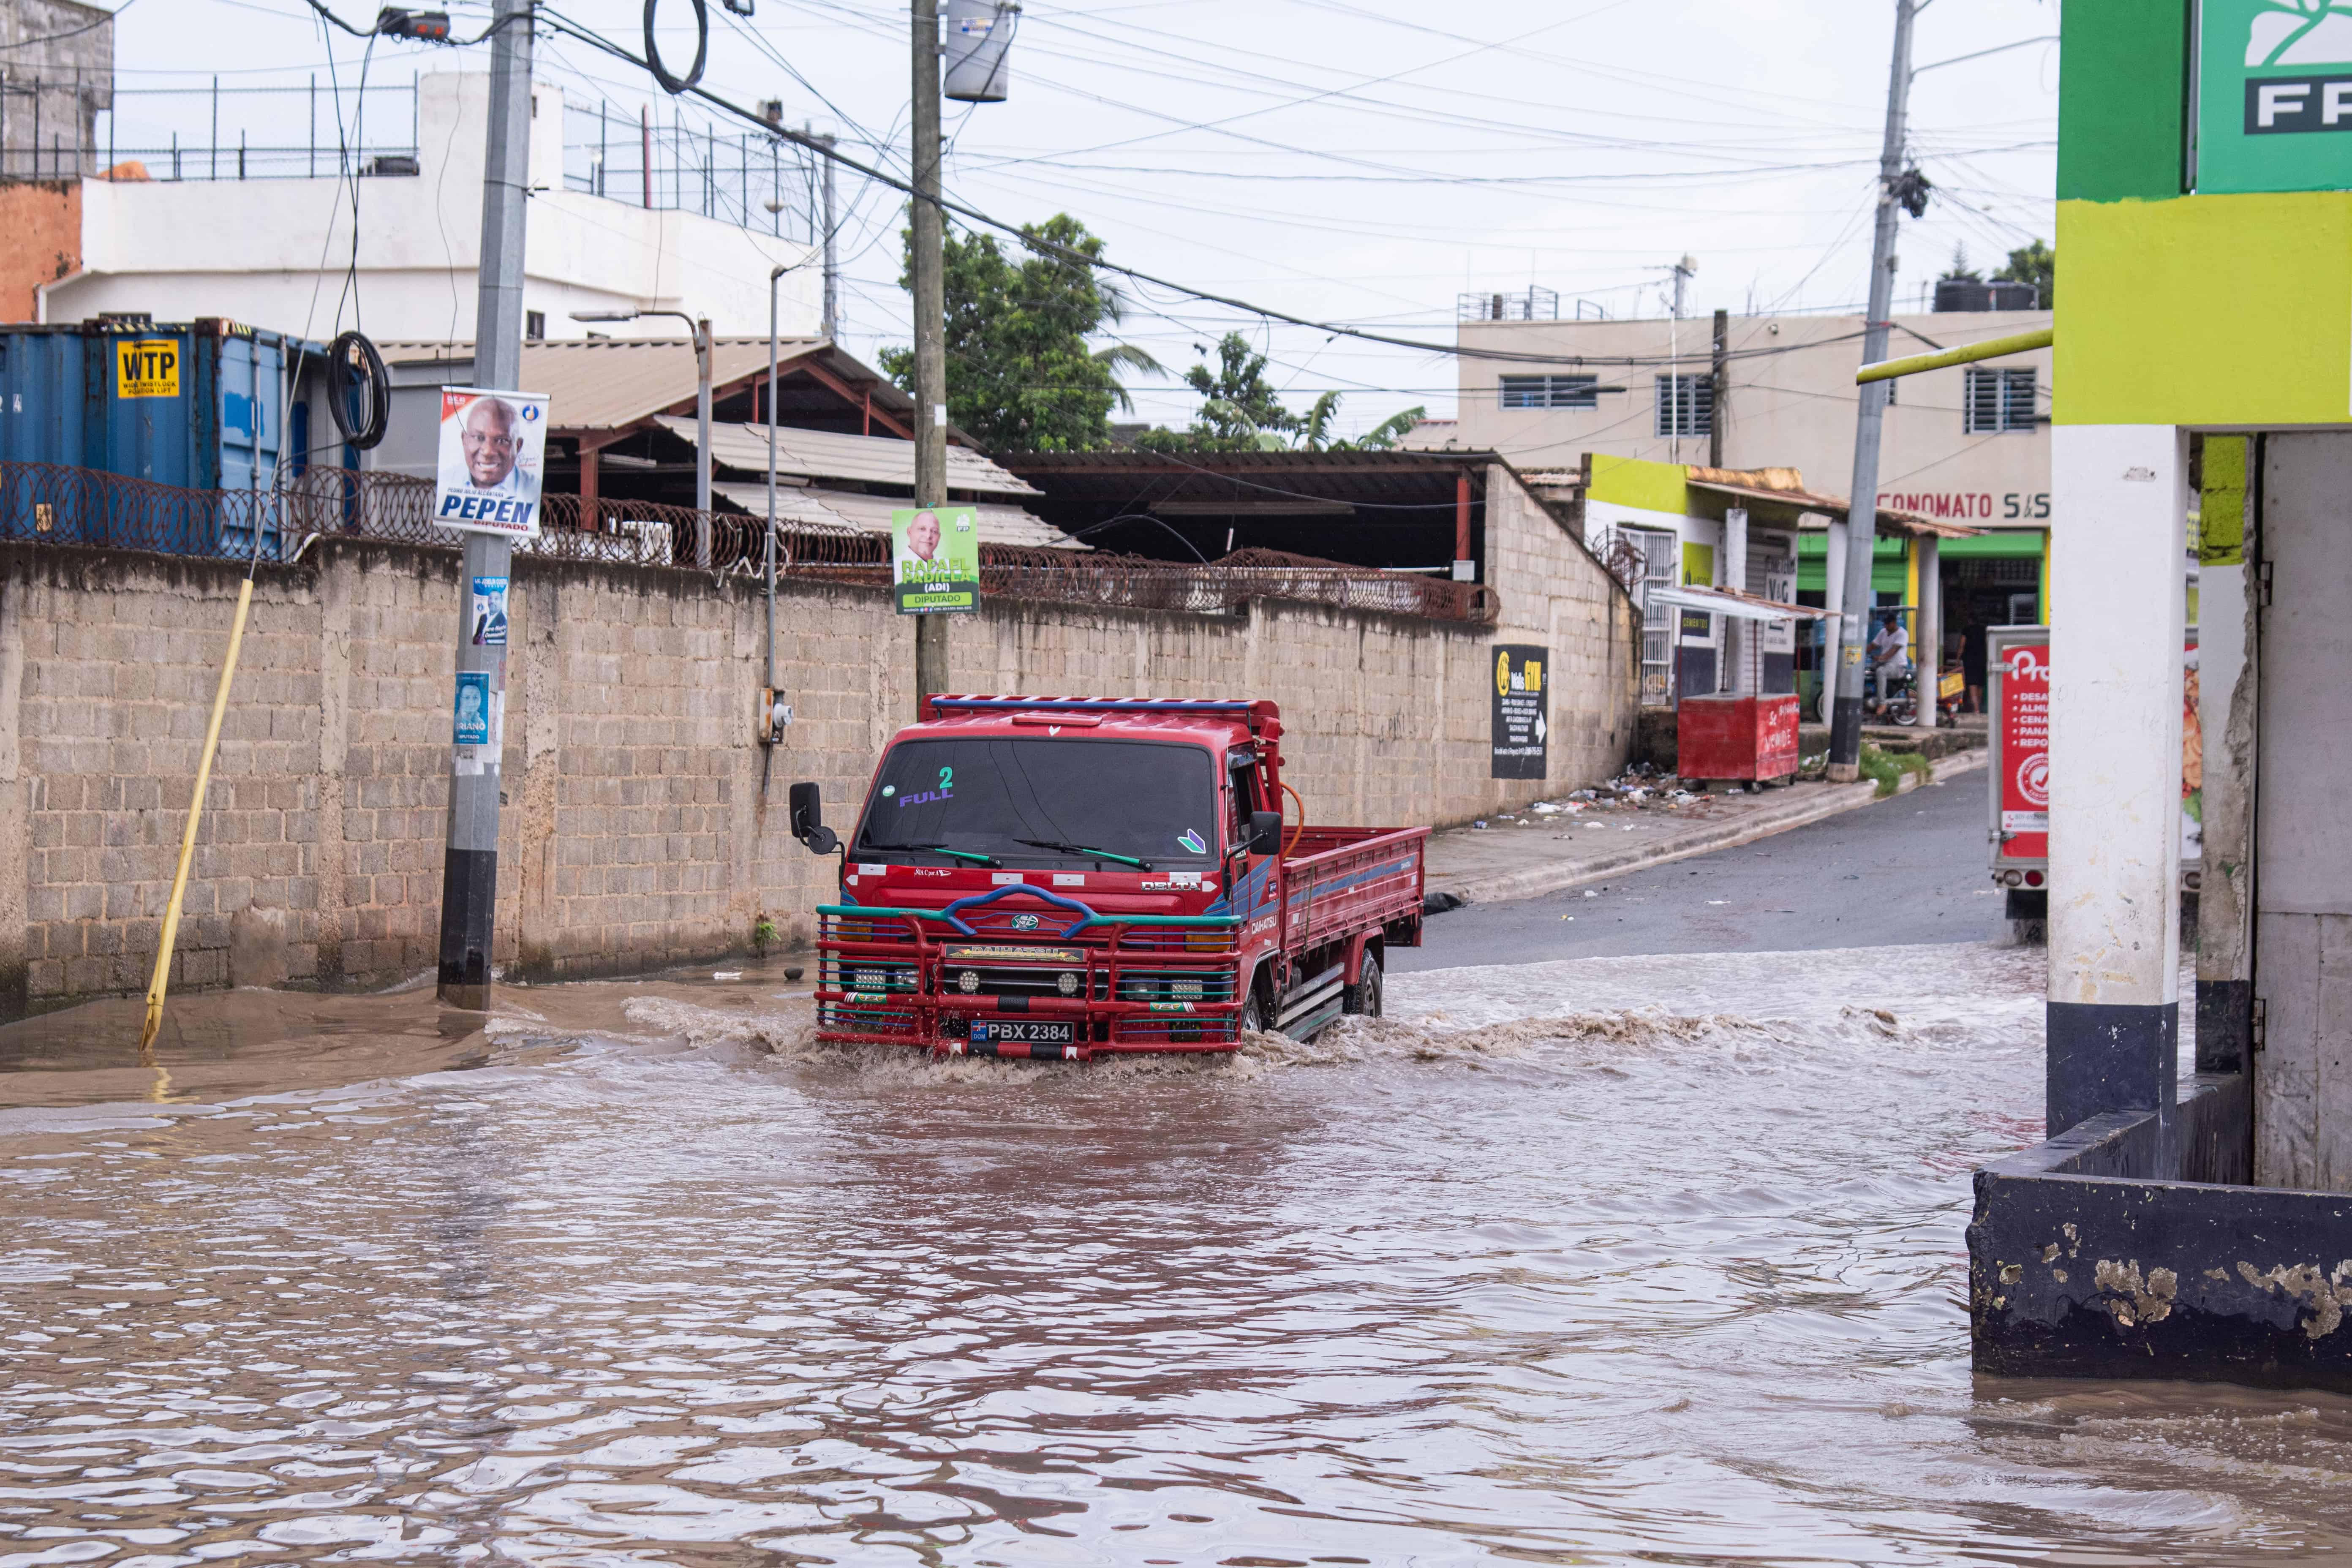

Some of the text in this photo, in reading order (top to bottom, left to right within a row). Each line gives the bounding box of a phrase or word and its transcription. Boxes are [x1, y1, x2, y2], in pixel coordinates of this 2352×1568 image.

[123, 351, 175, 381] WTP
[440, 495, 533, 523] PEPÉN
[473, 520, 528, 531] DIPUTADO
[902, 558, 971, 572] RAFAEL
[902, 570, 971, 584] PADILLA
[924, 583, 950, 593] (ADI)
[915, 594, 961, 603] DIPUTADO
[939, 767, 953, 789] 2
[900, 788, 953, 808] FULL
[1235, 849, 1247, 858] DELTA
[1141, 882, 1200, 891] DELTA
[1252, 915, 1277, 934] DAIHATSU
[972, 946, 1058, 957] DAIHATSU
[988, 1024, 1070, 1040] PBX 2384
